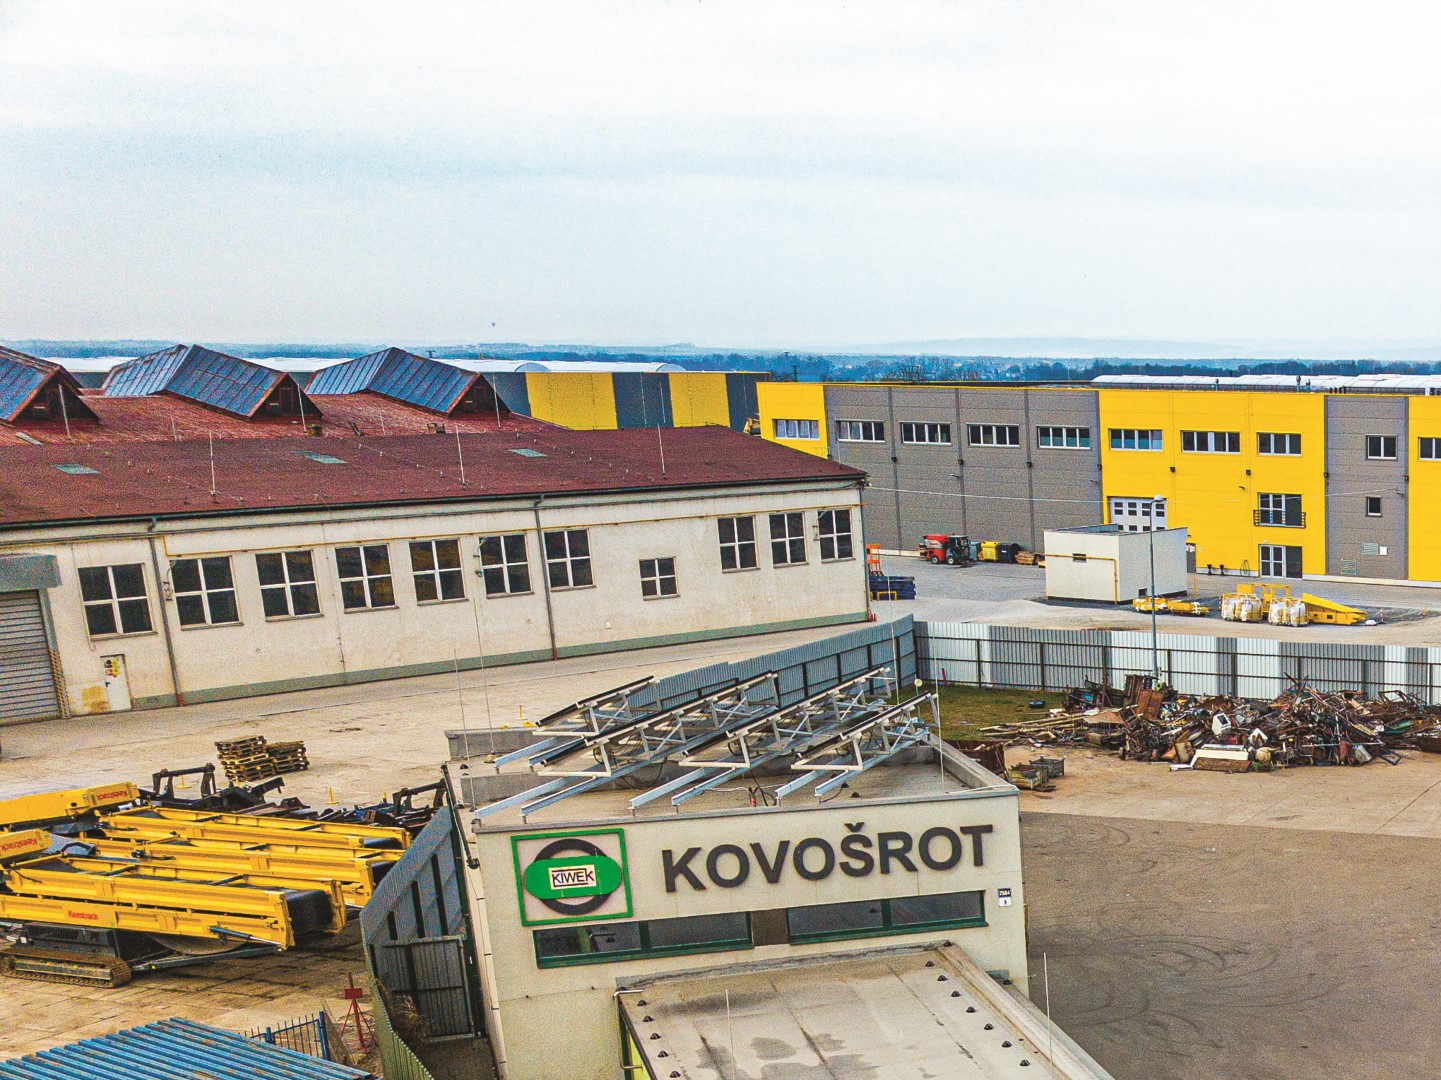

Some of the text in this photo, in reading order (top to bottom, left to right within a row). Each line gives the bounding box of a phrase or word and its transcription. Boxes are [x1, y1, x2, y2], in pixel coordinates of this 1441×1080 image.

[661, 822, 994, 892] KOVOŠROT
[552, 869, 594, 886] KIWEK
[68, 910, 99, 920] Keestrack
